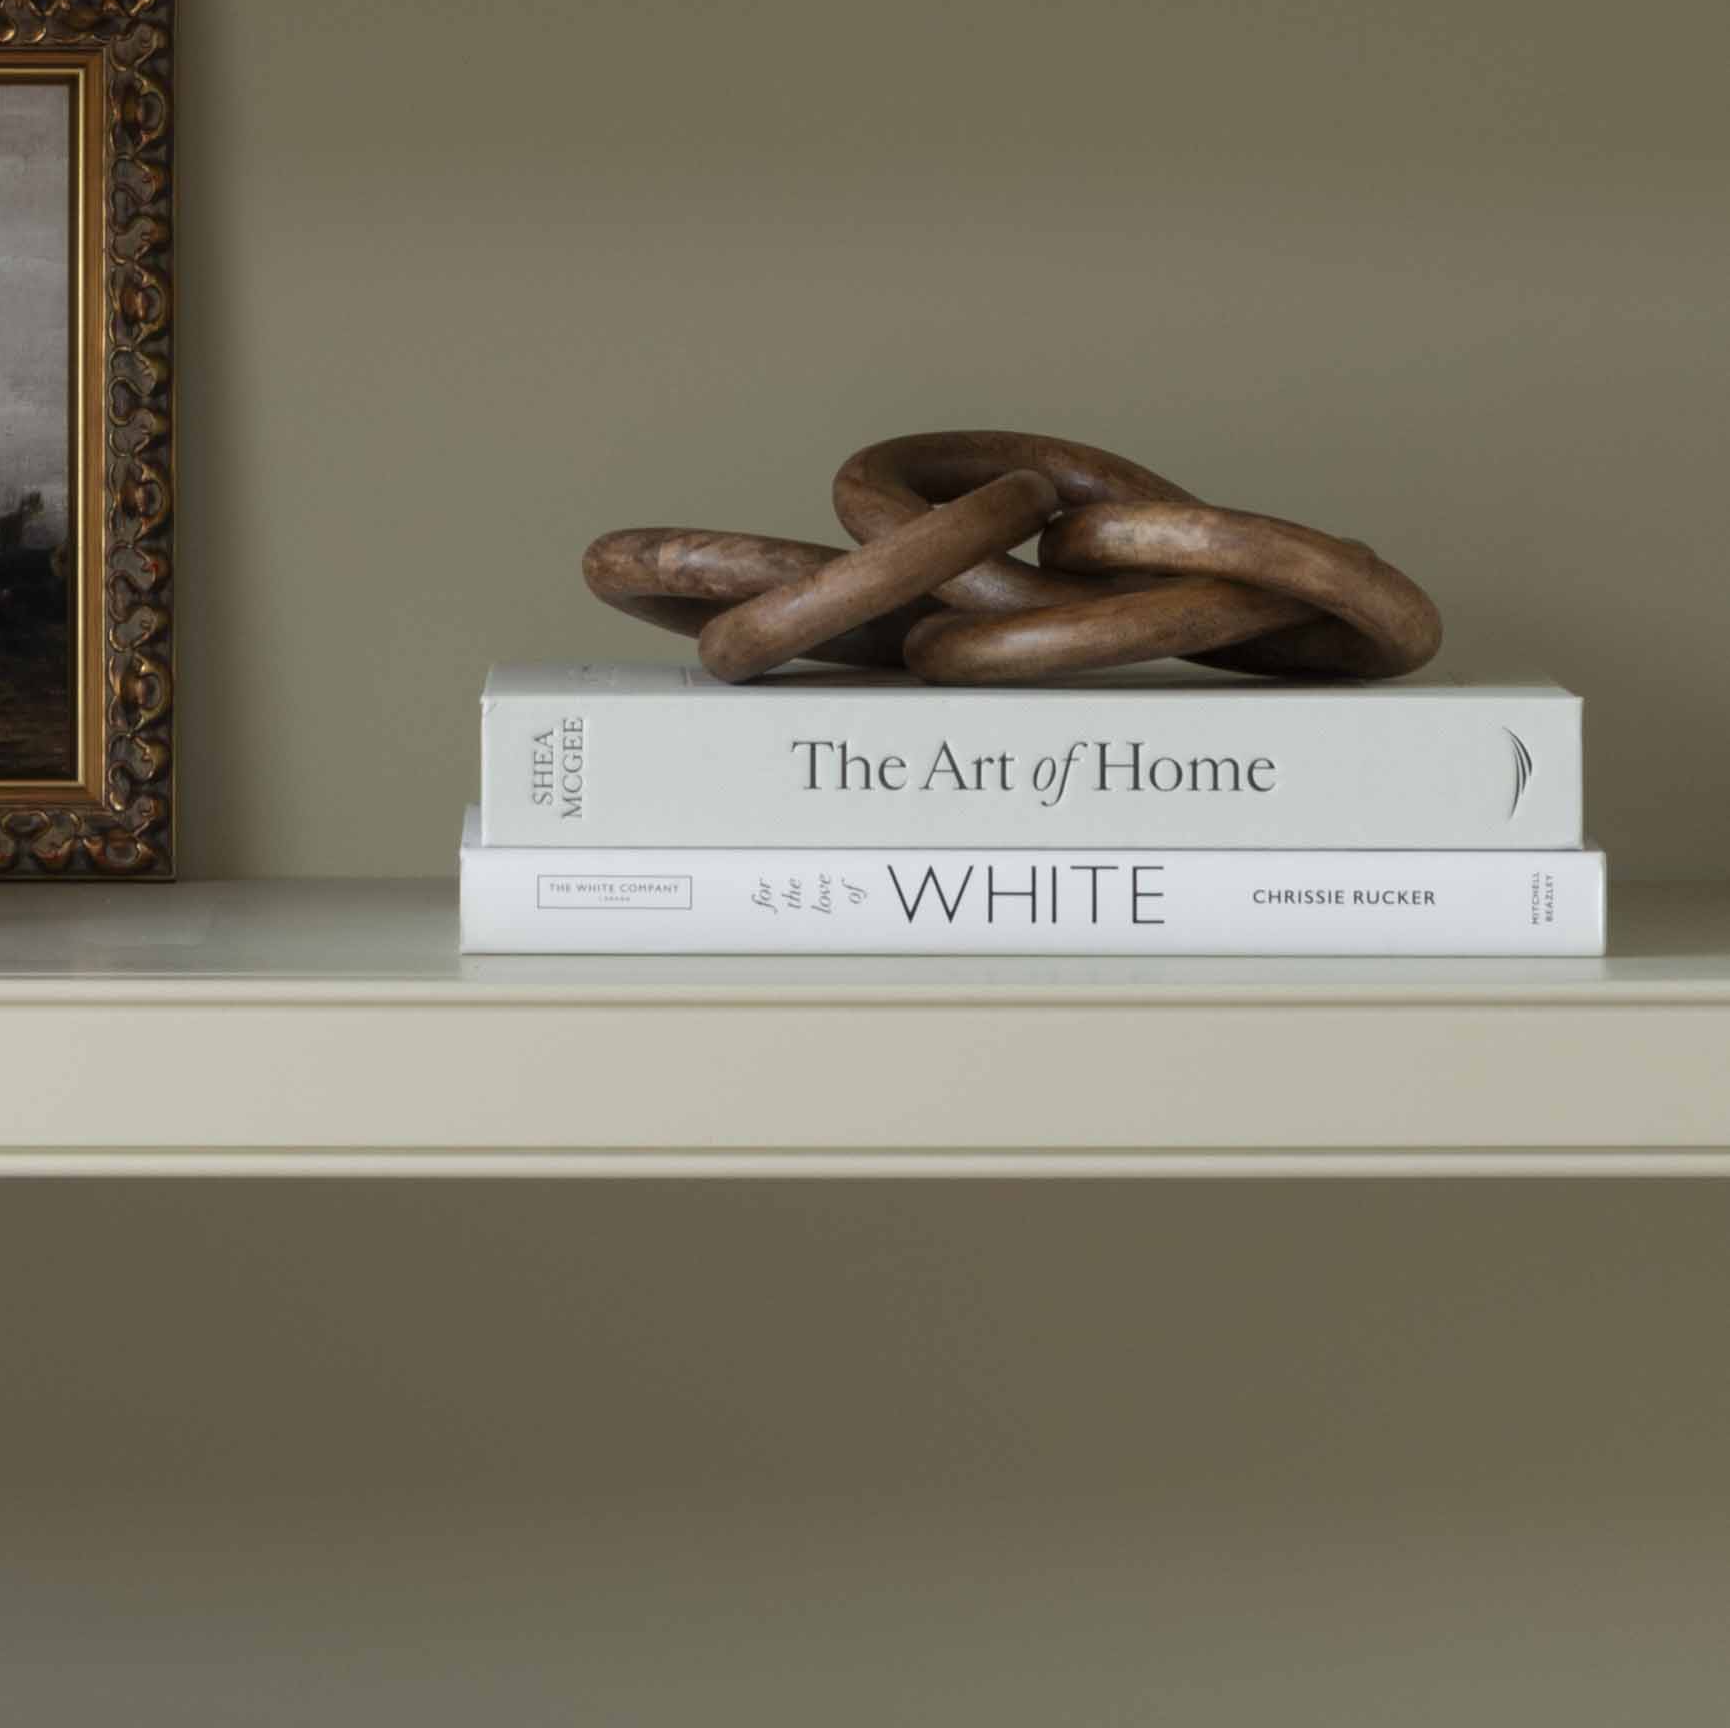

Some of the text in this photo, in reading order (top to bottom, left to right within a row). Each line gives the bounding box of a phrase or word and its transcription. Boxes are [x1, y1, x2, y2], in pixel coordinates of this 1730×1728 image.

[533, 728, 554, 805] SHEA
[562, 718, 583, 819] MCGEE
[791, 741, 1276, 807] The Art of Home
[549, 882, 680, 894] THE WHITE COMPANY
[751, 877, 779, 915] for
[781, 878, 801, 909] the
[811, 873, 831, 914] love
[841, 877, 868, 904] of
[888, 865, 1165, 923] WHITE
[1253, 888, 1437, 906] CHRISSIE RUCKER
